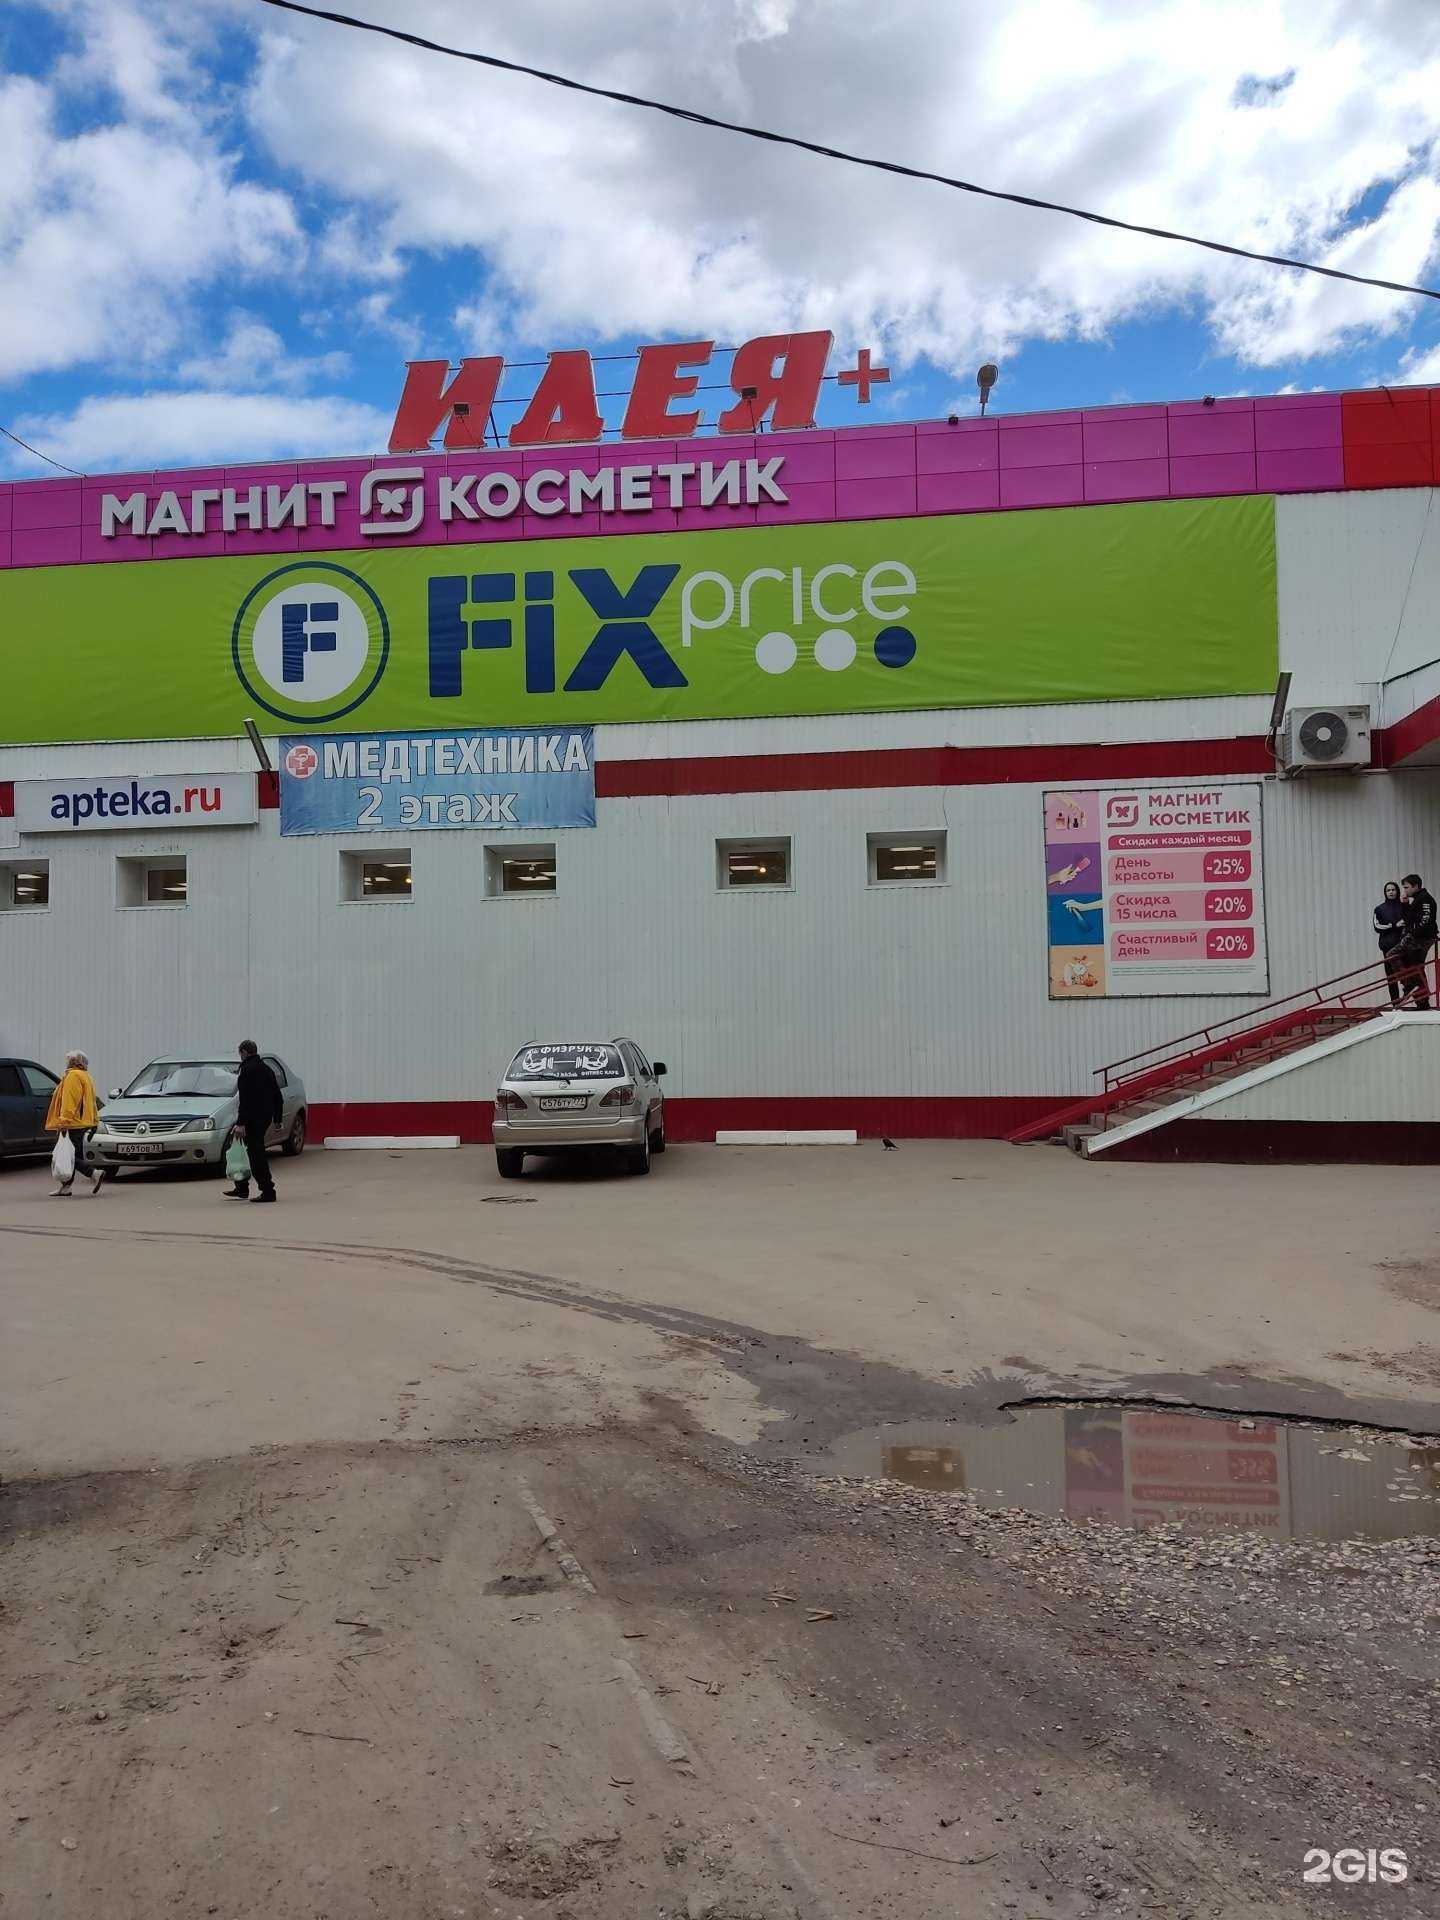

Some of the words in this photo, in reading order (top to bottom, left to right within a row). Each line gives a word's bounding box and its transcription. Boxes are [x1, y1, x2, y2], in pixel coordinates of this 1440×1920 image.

[100, 480, 348, 538] МАГНИТ
[438, 455, 789, 522] КОСМЕТИК
[681, 558, 918, 648] price
[322, 733, 591, 784] МЕДТЕХНИКА
[51, 781, 221, 826] apteka.ru
[357, 787, 386, 827] 2
[398, 789, 519, 825] этаж
[1148, 792, 1223, 808] МАГНИТ
[1149, 810, 1251, 826] КОСМЕТИК
[1118, 836, 1159, 847] Скидки
[1161, 834, 1206, 845] каждый
[1208, 835, 1241, 845] месяц
[1115, 857, 1152, 870] День
[1206, 858, 1245, 875] -25%
[1115, 871, 1174, 883] красоты
[1116, 894, 1171, 908] Скидка
[1208, 897, 1247, 913] -20%
[1116, 907, 1131, 919] 15
[1133, 908, 1177, 920] числа
[1117, 931, 1199, 945] Счастливый
[1209, 935, 1248, 952] -20%
[1118, 946, 1151, 957] день
[540, 1045, 593, 1054] ФИЗРУК
